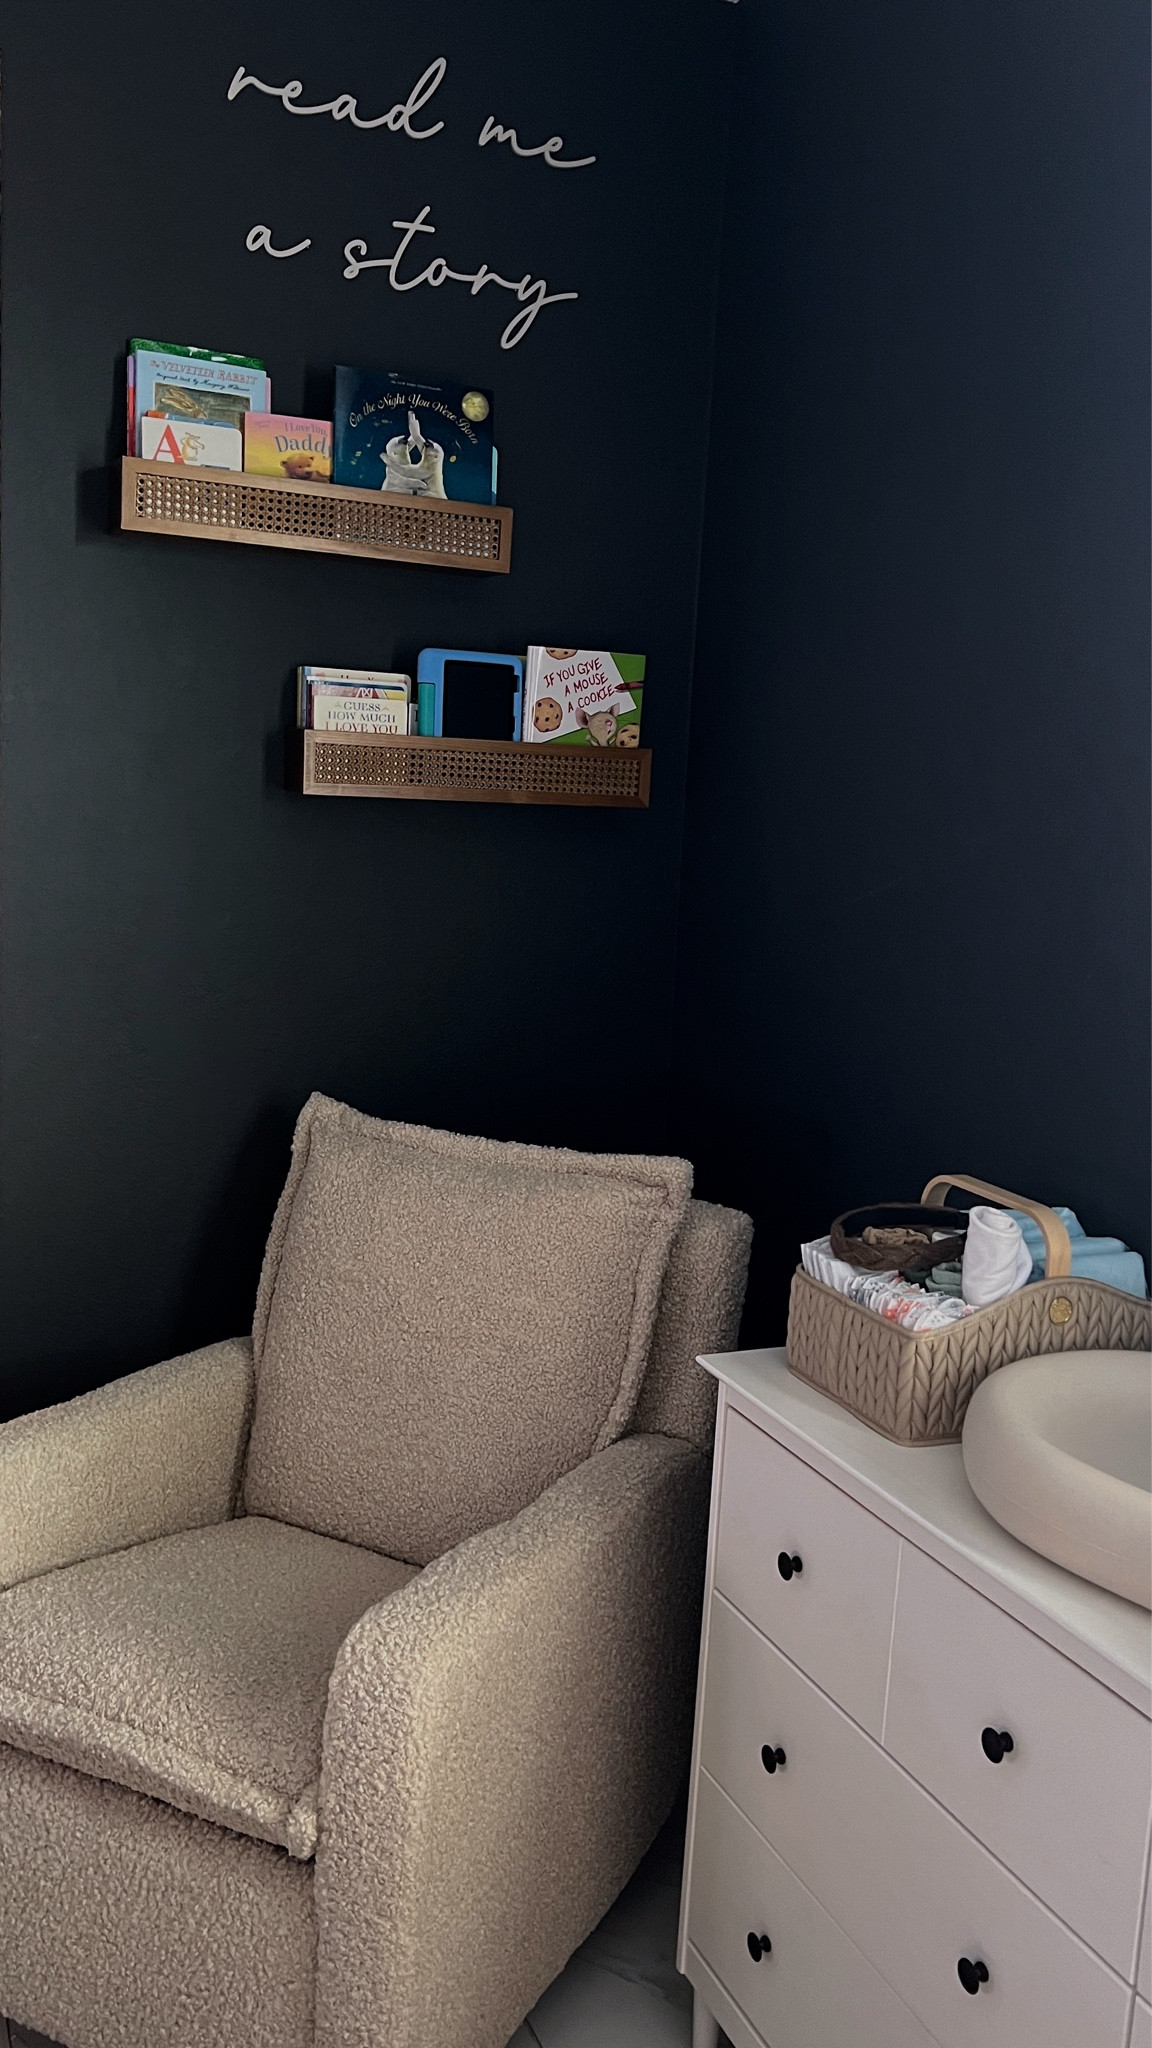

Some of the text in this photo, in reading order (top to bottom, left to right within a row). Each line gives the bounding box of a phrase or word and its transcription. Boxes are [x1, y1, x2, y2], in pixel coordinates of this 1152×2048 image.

[227, 57, 596, 168] read me
[245, 205, 579, 349] a story
[161, 361, 214, 378] VELVETEEN
[218, 369, 258, 385] RABBIT
[285, 422, 289, 432] I
[290, 423, 310, 432] Love
[349, 392, 478, 444] On the Night You Were Born
[154, 424, 186, 465] A
[543, 657, 603, 689] IF YOU GIVE
[564, 672, 609, 697] A MOUSE
[343, 701, 381, 712] GUESS
[568, 684, 616, 713] A COOKIE
[325, 721, 399, 735] I LOVE YOU
[328, 710, 396, 723] HOW MUCH
